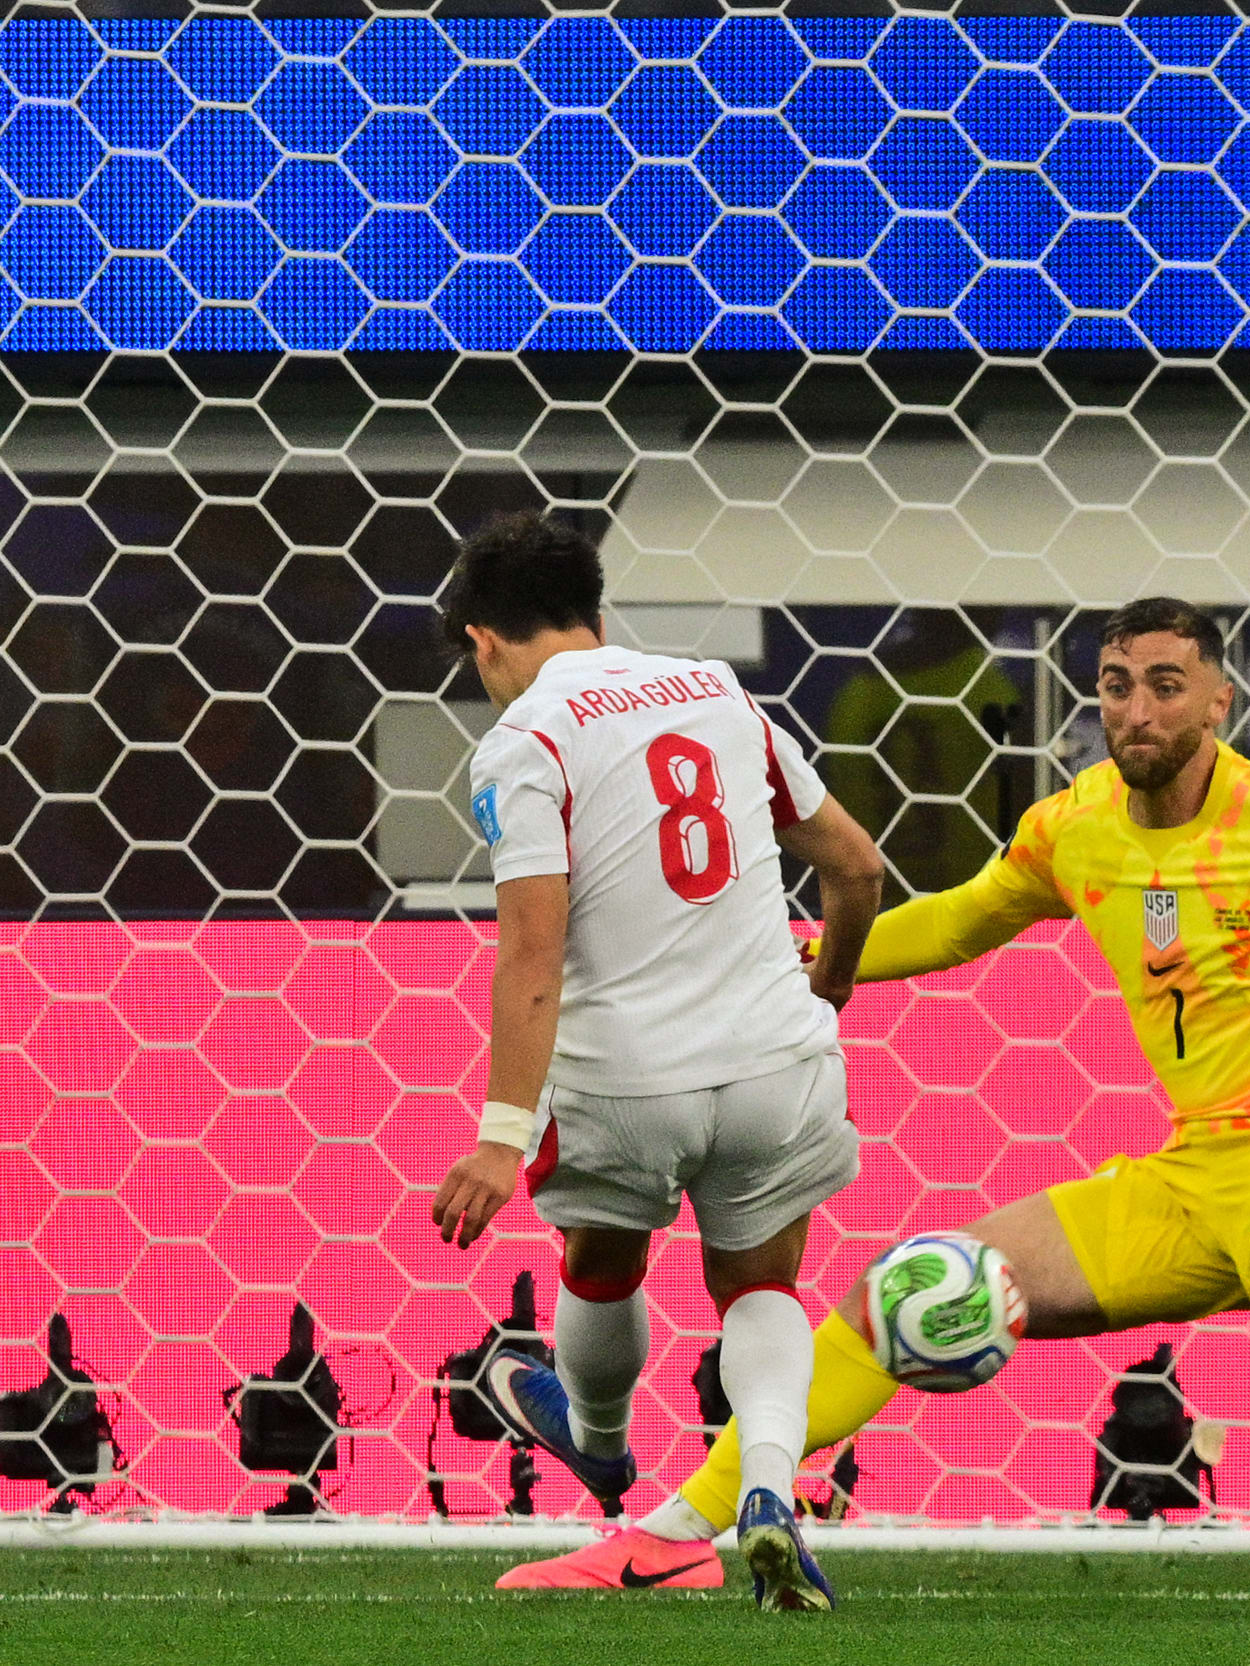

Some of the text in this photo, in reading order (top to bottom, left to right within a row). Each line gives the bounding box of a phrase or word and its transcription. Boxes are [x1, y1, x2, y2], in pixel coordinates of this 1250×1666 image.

[566, 671, 735, 728] ARDA GÜLER
[646, 732, 740, 904] 8
[1145, 893, 1174, 916] USA
[1171, 988, 1186, 1060] 1
